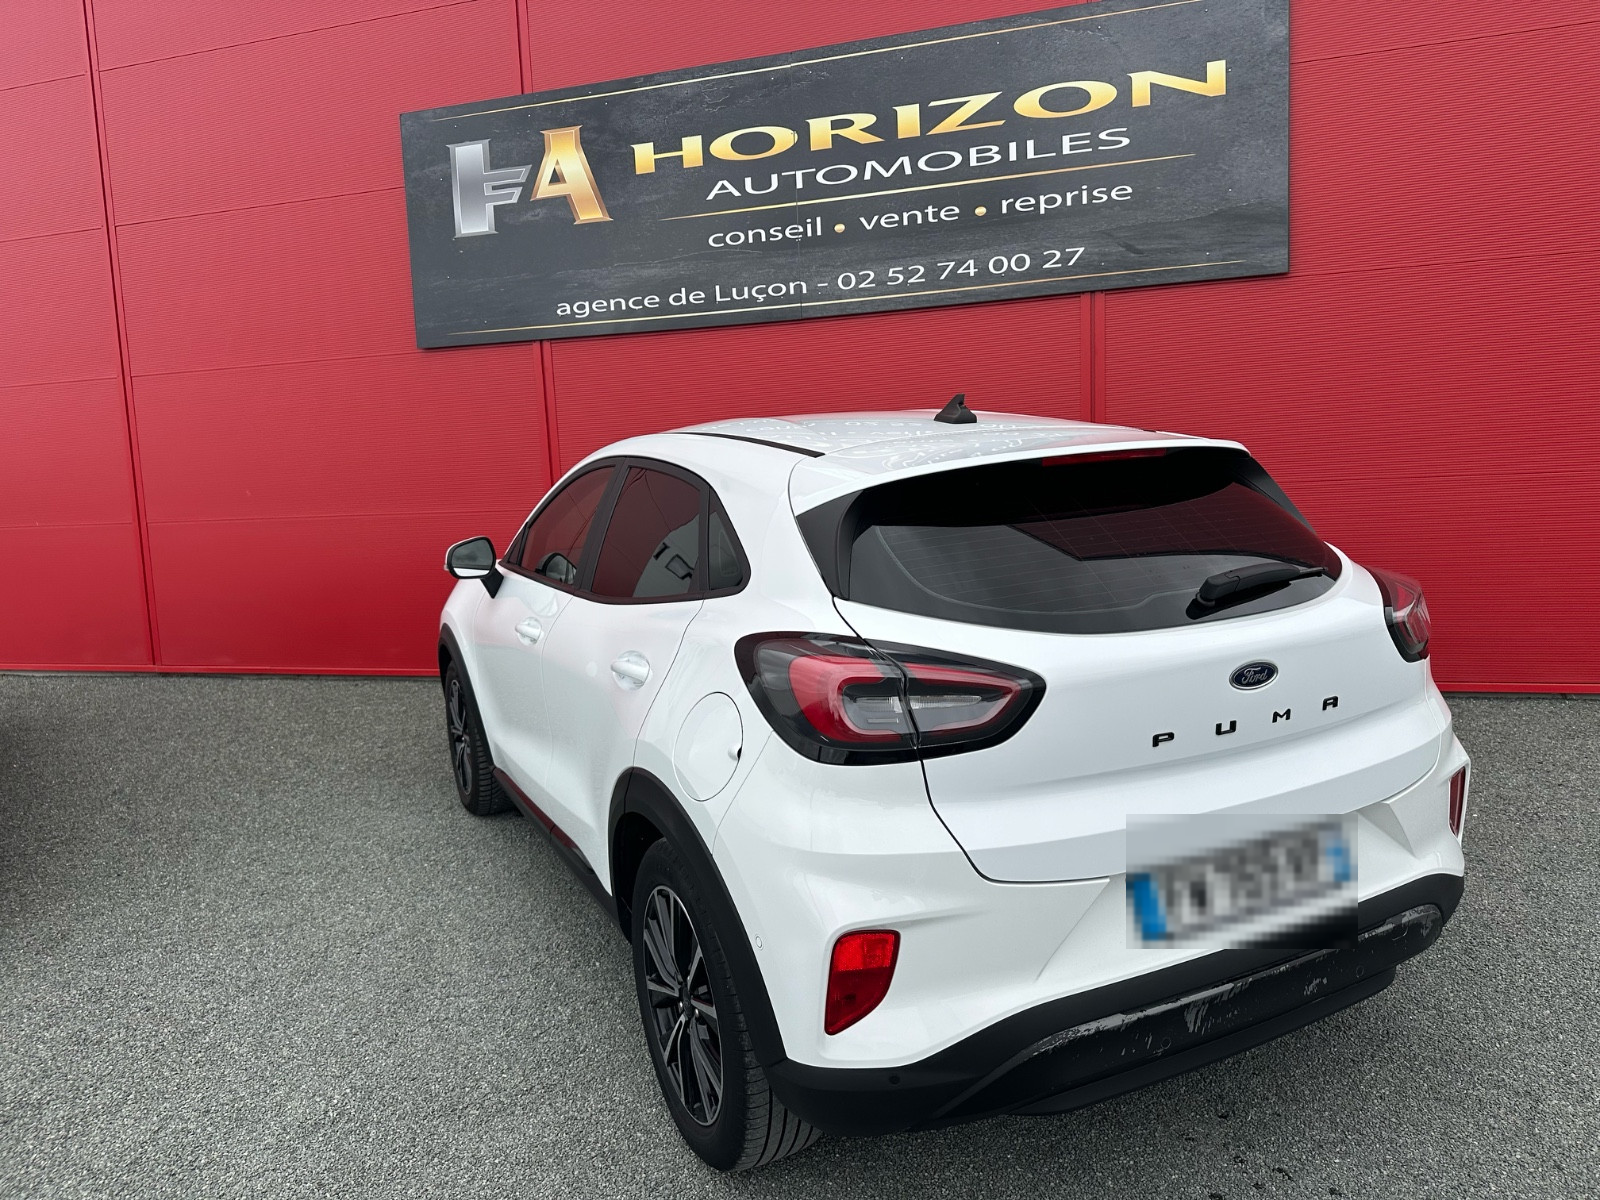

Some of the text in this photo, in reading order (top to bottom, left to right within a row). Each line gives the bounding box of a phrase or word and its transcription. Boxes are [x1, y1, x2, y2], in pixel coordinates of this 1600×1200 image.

[630, 58, 1227, 176] HORIZON
[705, 127, 1131, 201] AUTOMOBILES
[708, 184, 1133, 248] conseil vente reprise
[556, 294, 660, 318] agence
[668, 287, 706, 307] de
[715, 279, 807, 302] Luçon
[837, 271, 875, 290] 02
[887, 265, 925, 284] 52
[938, 259, 978, 280] 74
[988, 253, 1031, 274] 00
[1042, 247, 1086, 269] 27
[1152, 695, 1339, 748] PUMA
